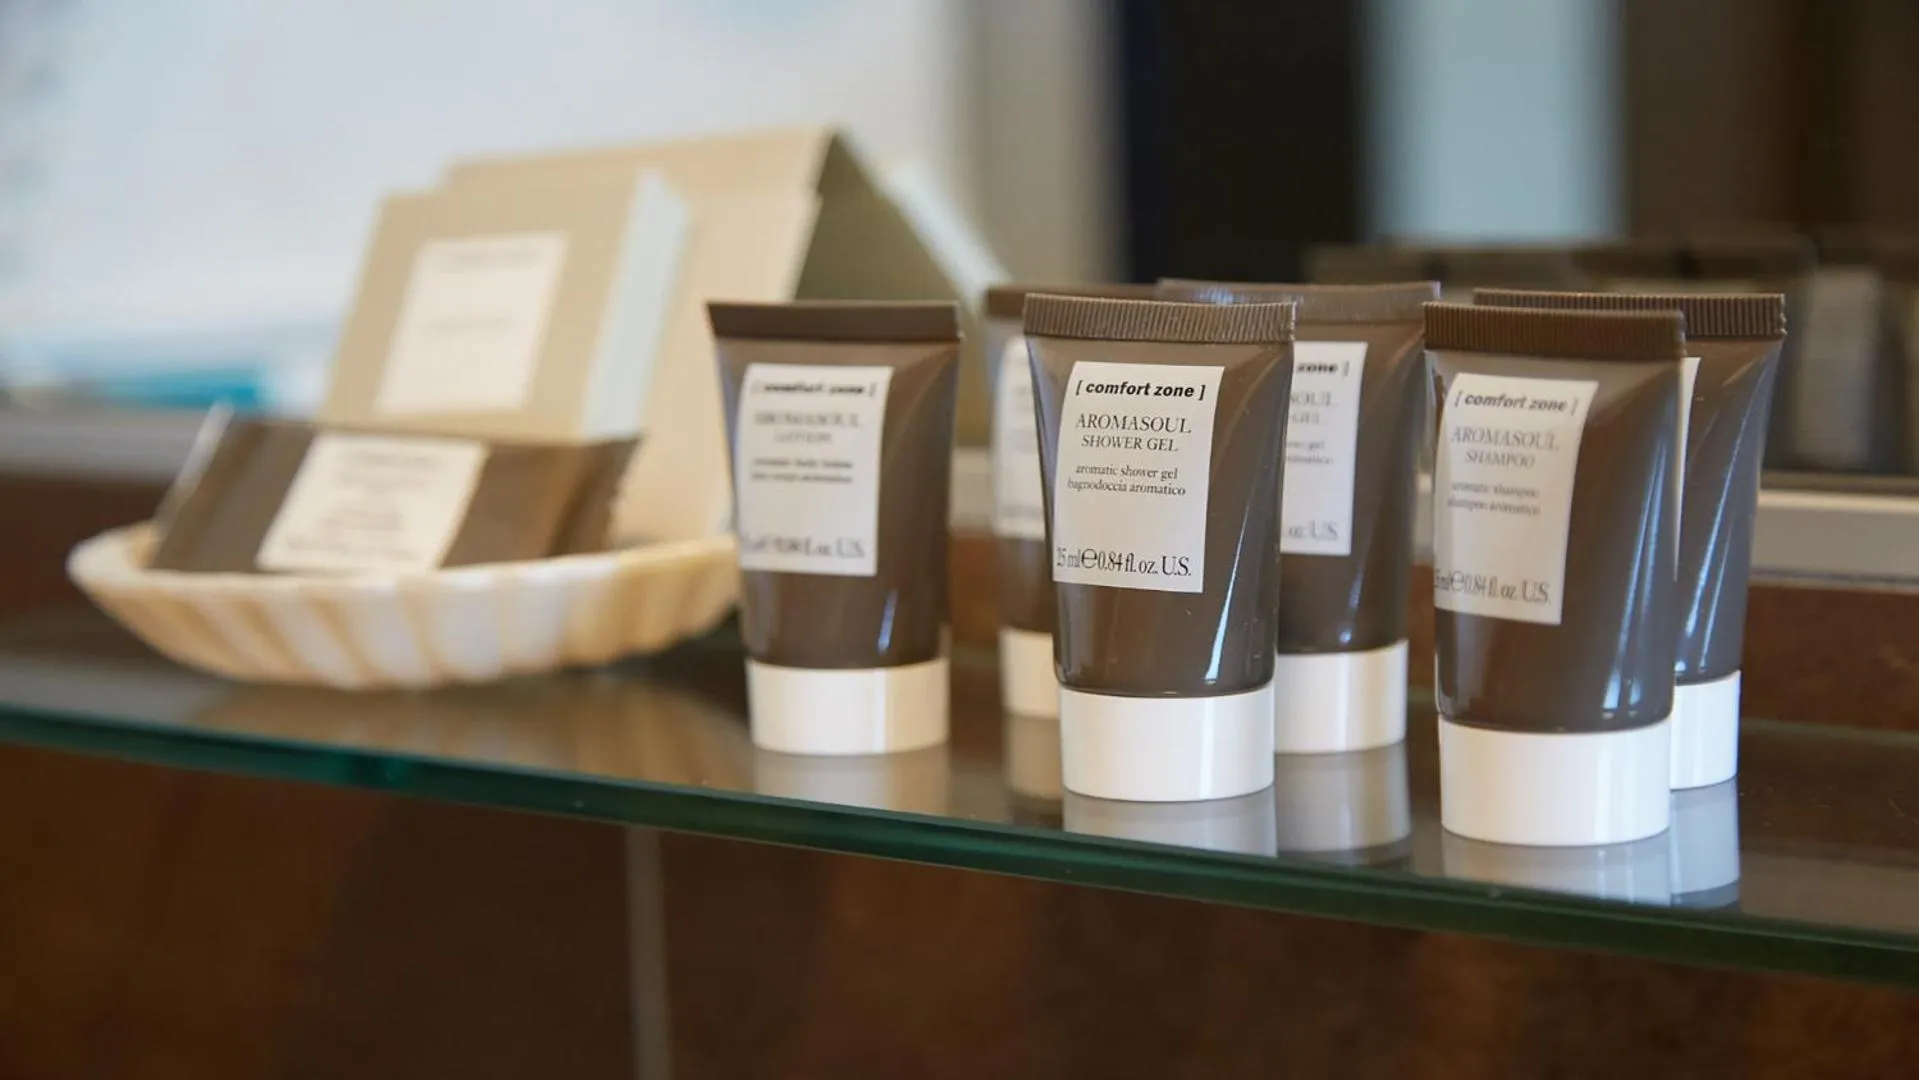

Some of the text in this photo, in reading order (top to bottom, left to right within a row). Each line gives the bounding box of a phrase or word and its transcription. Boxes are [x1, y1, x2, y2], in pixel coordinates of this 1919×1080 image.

[1297, 362, 1339, 373] zone
[1086, 381, 1151, 396] comfort
[1154, 384, 1195, 398] zone
[1465, 392, 1527, 409] comfort
[1529, 400, 1568, 412] zone
[1075, 413, 1193, 434] AROMASOUL
[1081, 434, 1179, 452] SHOWER GEL
[1451, 426, 1560, 450] AROMASOUL
[1464, 449, 1536, 468] SHAMPOO
[1075, 463, 1179, 482] aromatic shower gel
[1067, 476, 1186, 497] bagnodoccia aromatico
[1139, 559, 1159, 574] oz.
[1161, 554, 1192, 577] U.S.
